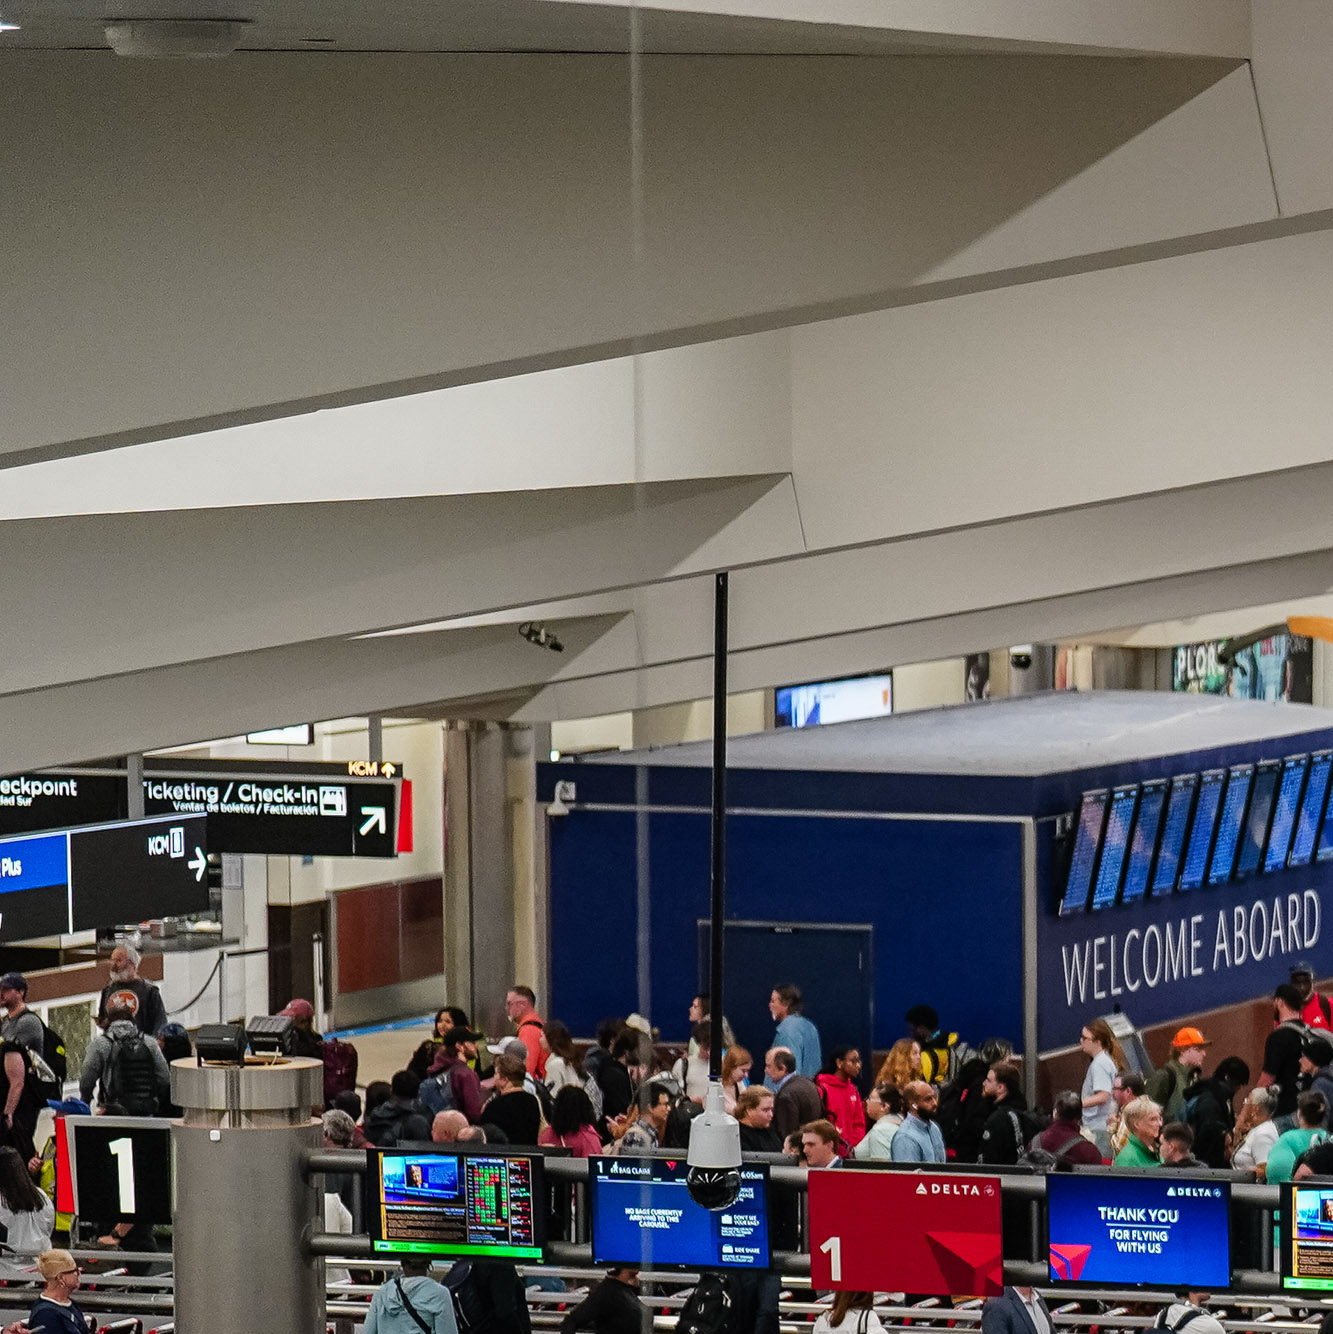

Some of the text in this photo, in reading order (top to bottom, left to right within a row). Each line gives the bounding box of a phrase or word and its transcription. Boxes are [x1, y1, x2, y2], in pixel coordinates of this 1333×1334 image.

[348, 761, 378, 776] KCM
[143, 782, 318, 804] icketing / Check-In
[17, 796, 33, 807] Sur
[173, 801, 205, 812] Ventas
[206, 802, 219, 812] de
[220, 803, 255, 814] boletos
[264, 803, 318, 816] Facturación
[148, 835, 170, 856] KCM
[2, 857, 22, 878] Plus
[1062, 889, 1320, 1006] WELCOME ABOARD
[108, 1138, 136, 1213] 1
[597, 1161, 651, 1175] 1 BAG CLAIM
[931, 1183, 980, 1196] DELTA
[1177, 1187, 1211, 1197] DELTA
[650, 1208, 683, 1217] CURRENTLY
[1098, 1206, 1178, 1223] THANK YOU
[1109, 1229, 1168, 1242] FOR FLYING
[1116, 1242, 1162, 1254] WITH US
[819, 1236, 842, 1282] 1
